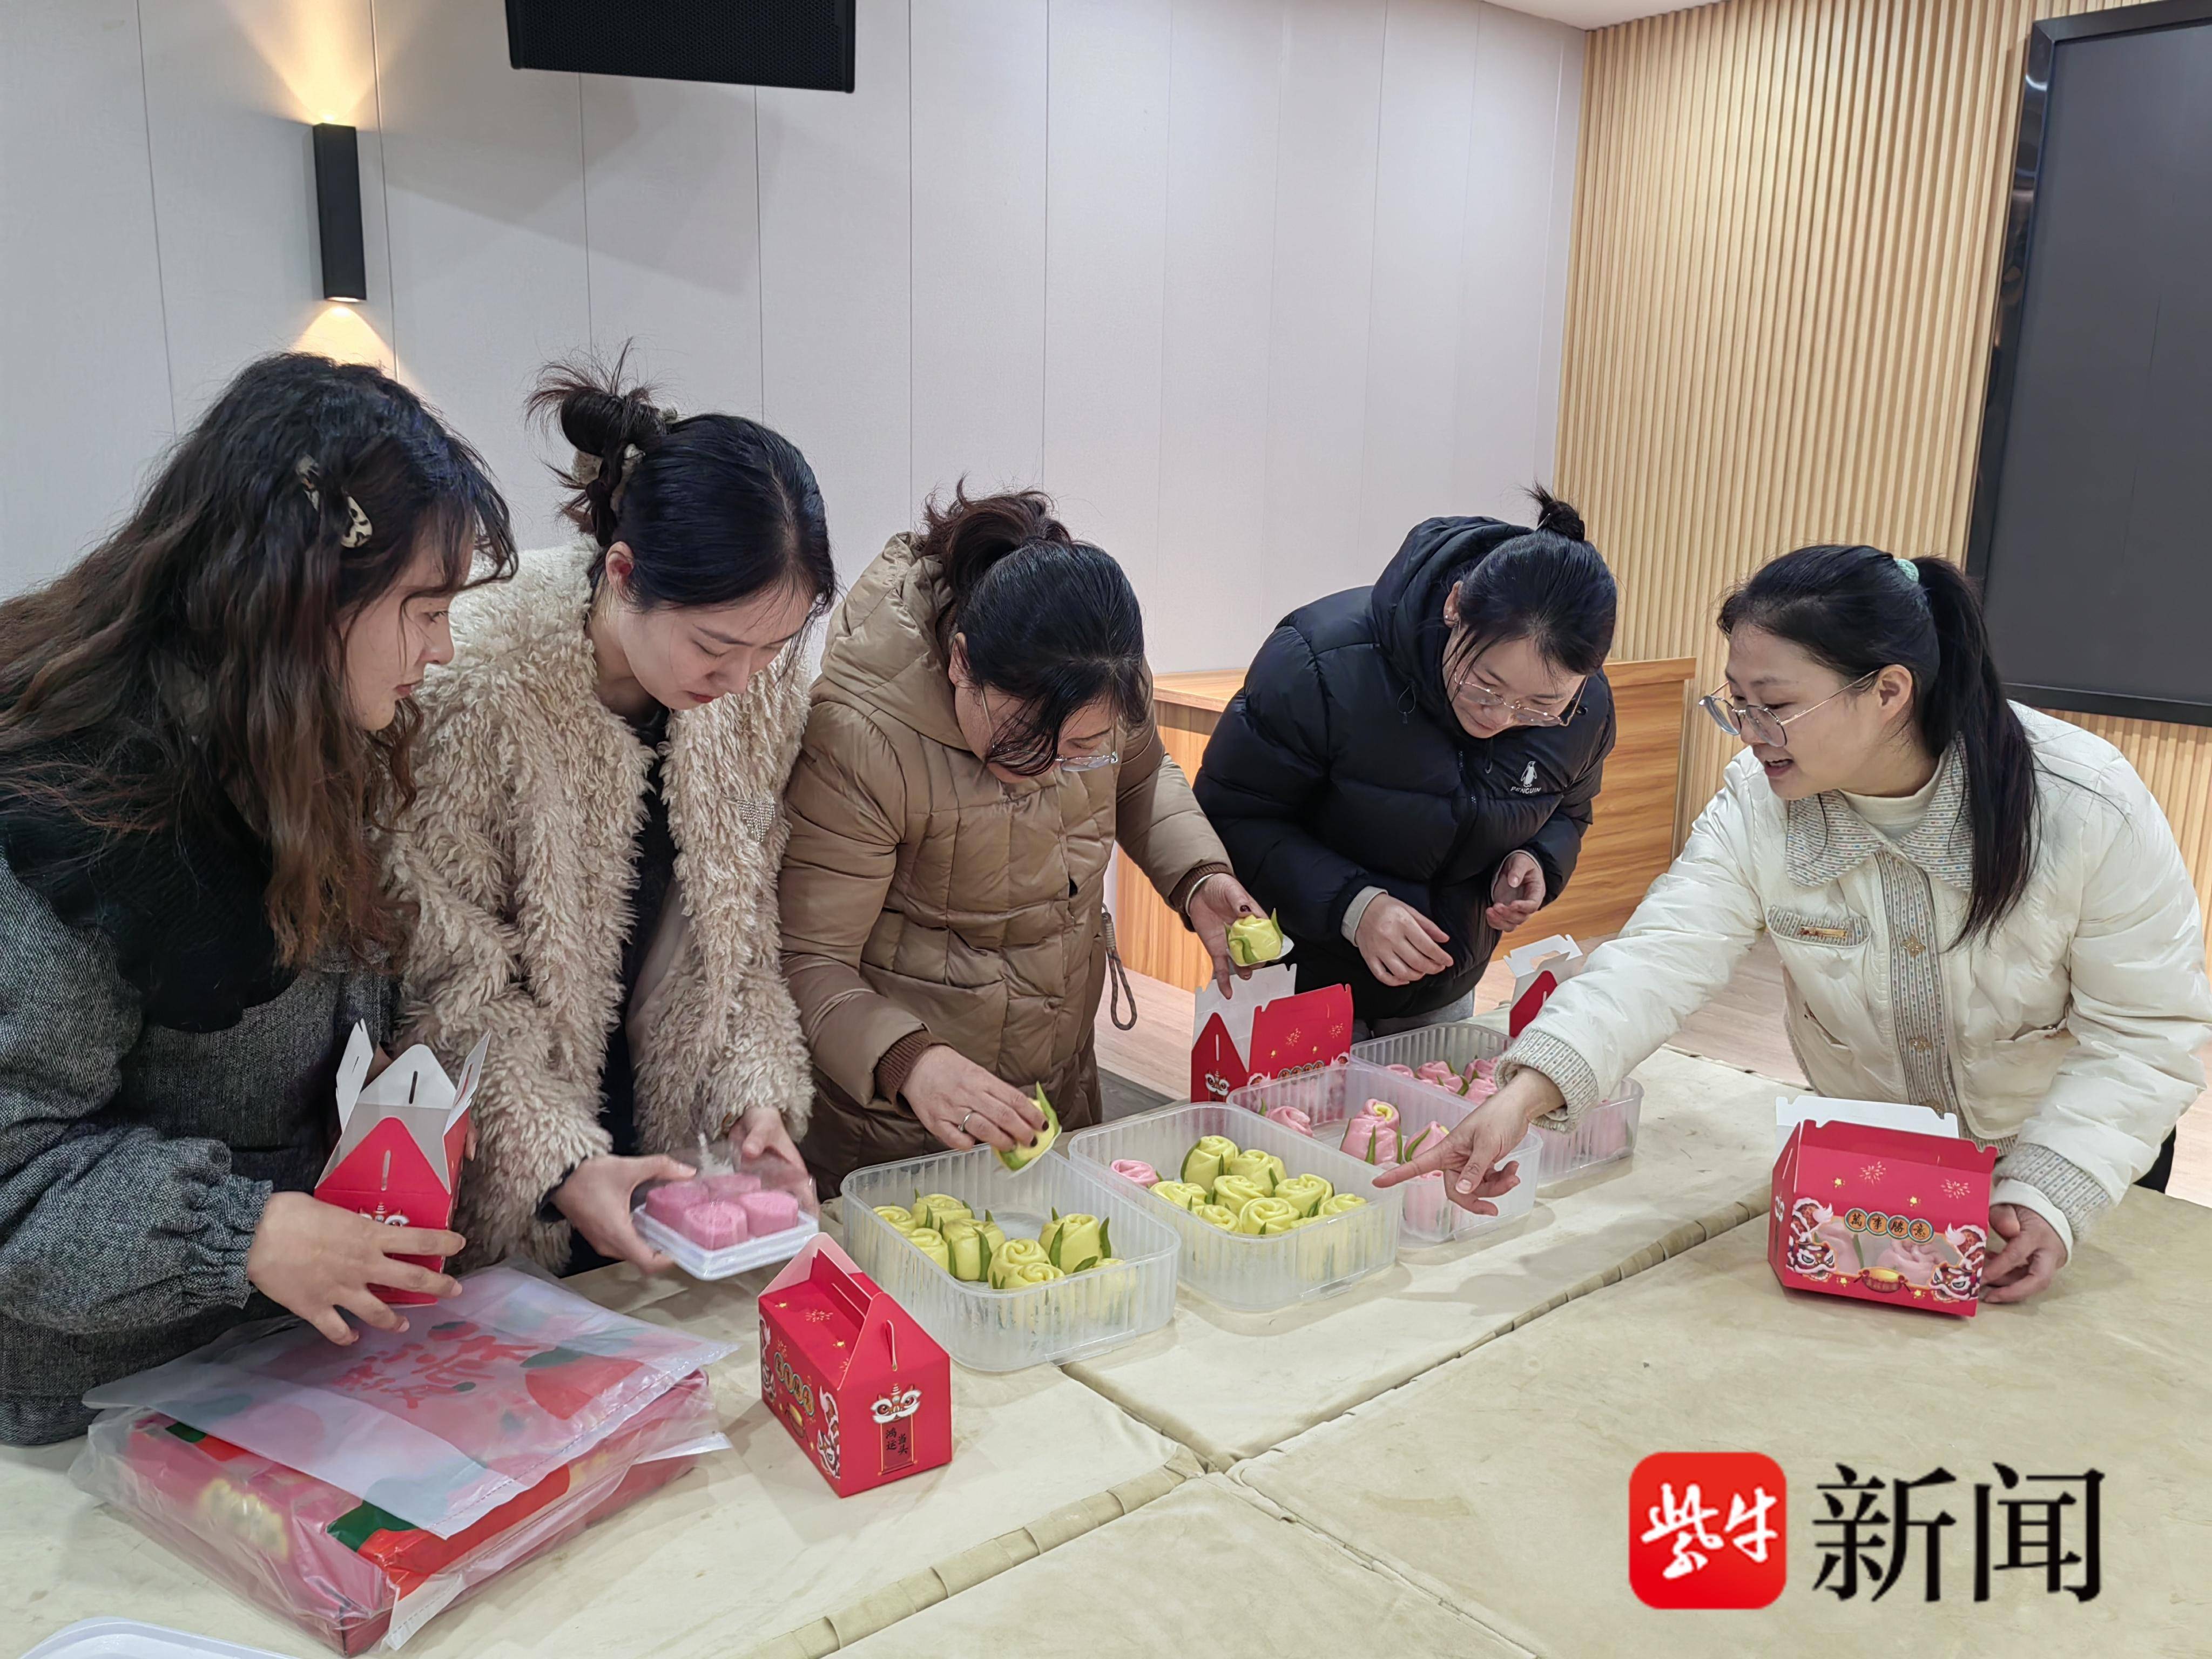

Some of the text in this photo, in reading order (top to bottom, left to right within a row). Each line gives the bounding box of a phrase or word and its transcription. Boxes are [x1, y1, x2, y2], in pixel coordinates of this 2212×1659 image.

[1510, 786, 1542, 794] PENGUIN
[886, 1427, 897, 1451] 鸿运
[898, 1433, 908, 1456] 当头
